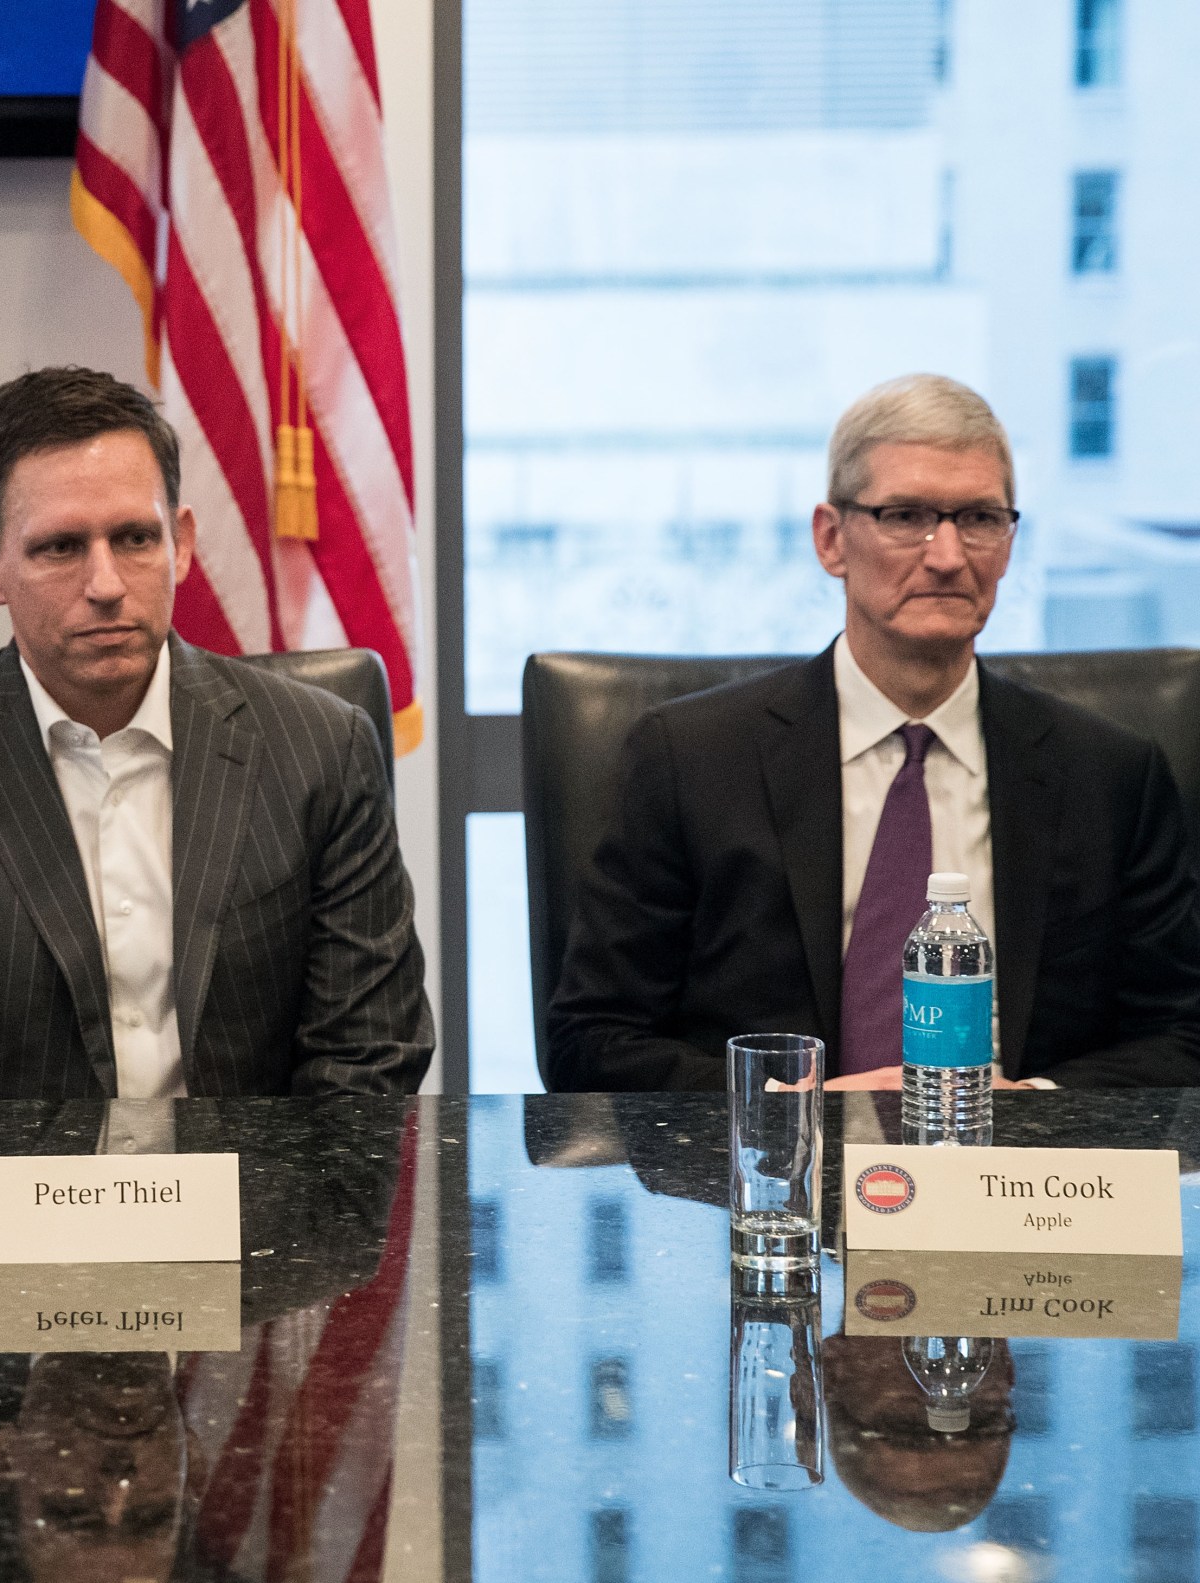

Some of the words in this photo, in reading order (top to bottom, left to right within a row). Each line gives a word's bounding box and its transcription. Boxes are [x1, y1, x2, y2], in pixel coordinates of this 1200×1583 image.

[35, 1182, 106, 1206] Peter
[113, 1179, 182, 1204] Thiel
[979, 1174, 1035, 1198] Tim
[1044, 1175, 1114, 1199] Cook
[1023, 1212, 1073, 1231] Apple
